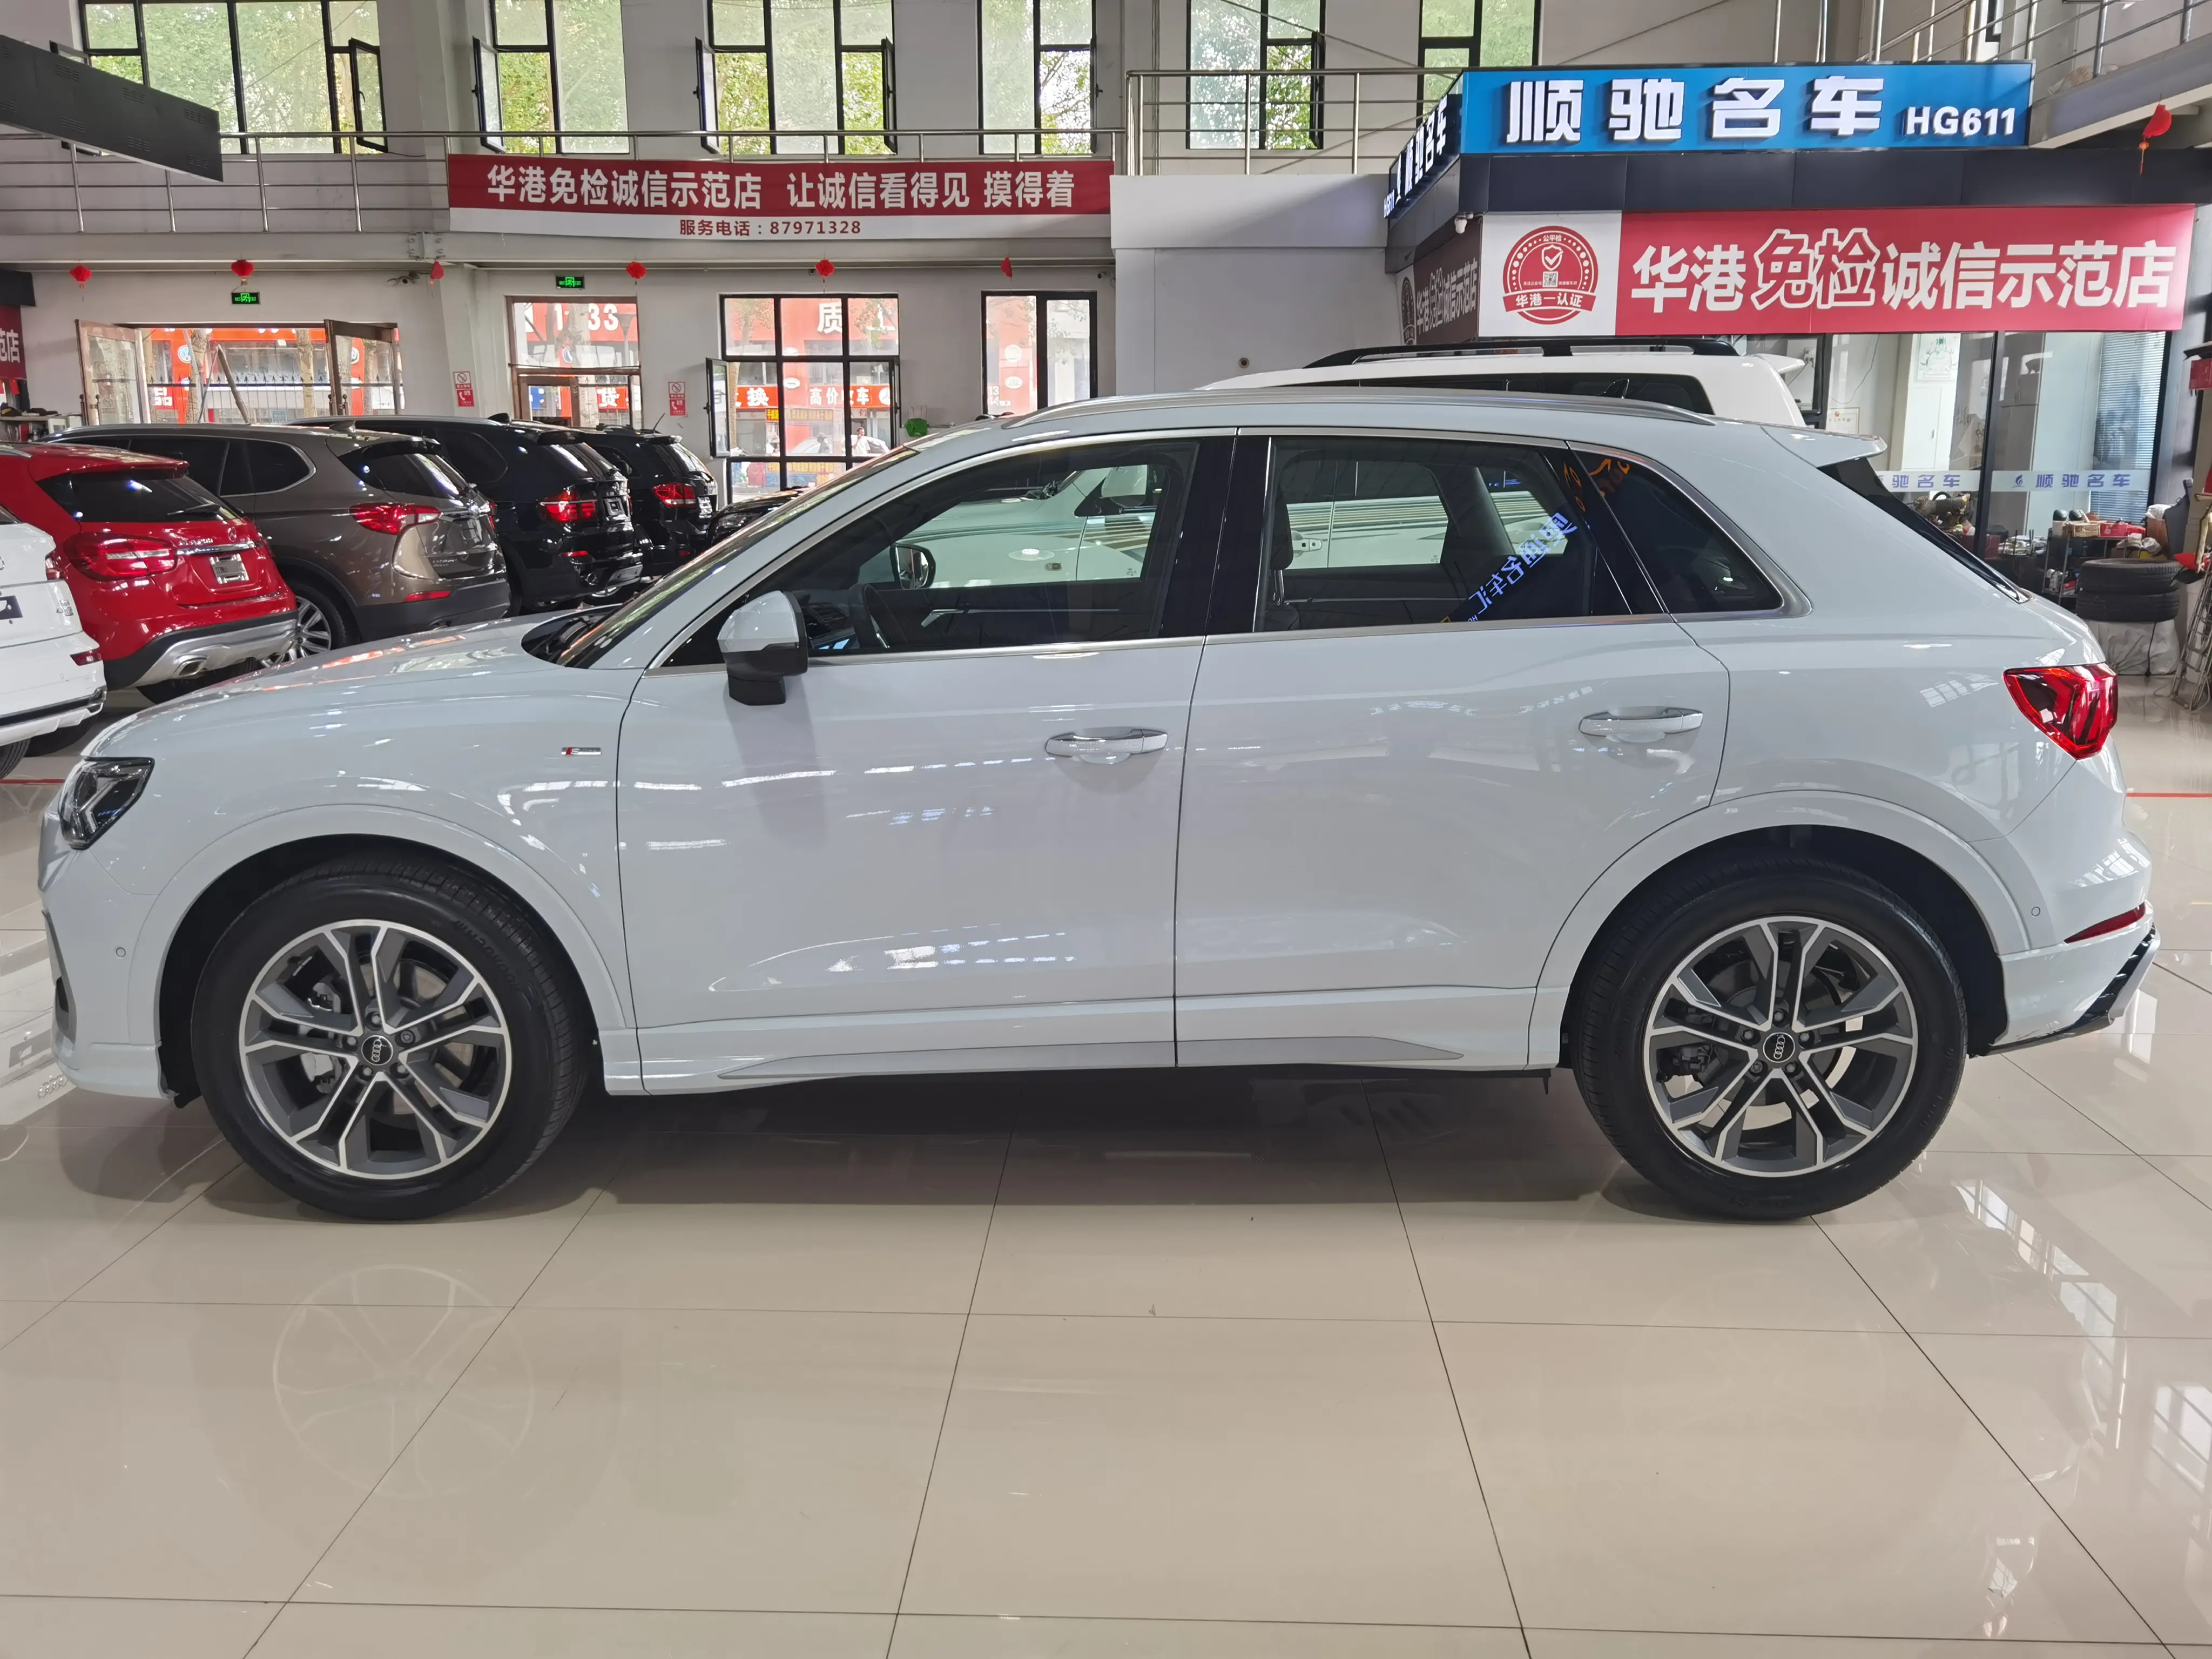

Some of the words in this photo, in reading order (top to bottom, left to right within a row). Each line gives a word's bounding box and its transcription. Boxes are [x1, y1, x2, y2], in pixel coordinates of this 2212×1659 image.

[1506, 76, 1884, 143] 顺驰名车
[1906, 106, 2015, 137] HG611
[487, 164, 762, 210] 华港免检诚信示范店
[787, 171, 970, 210] 让诚信看得见
[983, 170, 1075, 208] 摸得着
[1630, 227, 2177, 313] 华港免检诚信示范店
[1515, 292, 1583, 308] 华港一认证
[1878, 474, 1961, 488] 驰名车
[2035, 474, 2131, 488] 顺驰名车
